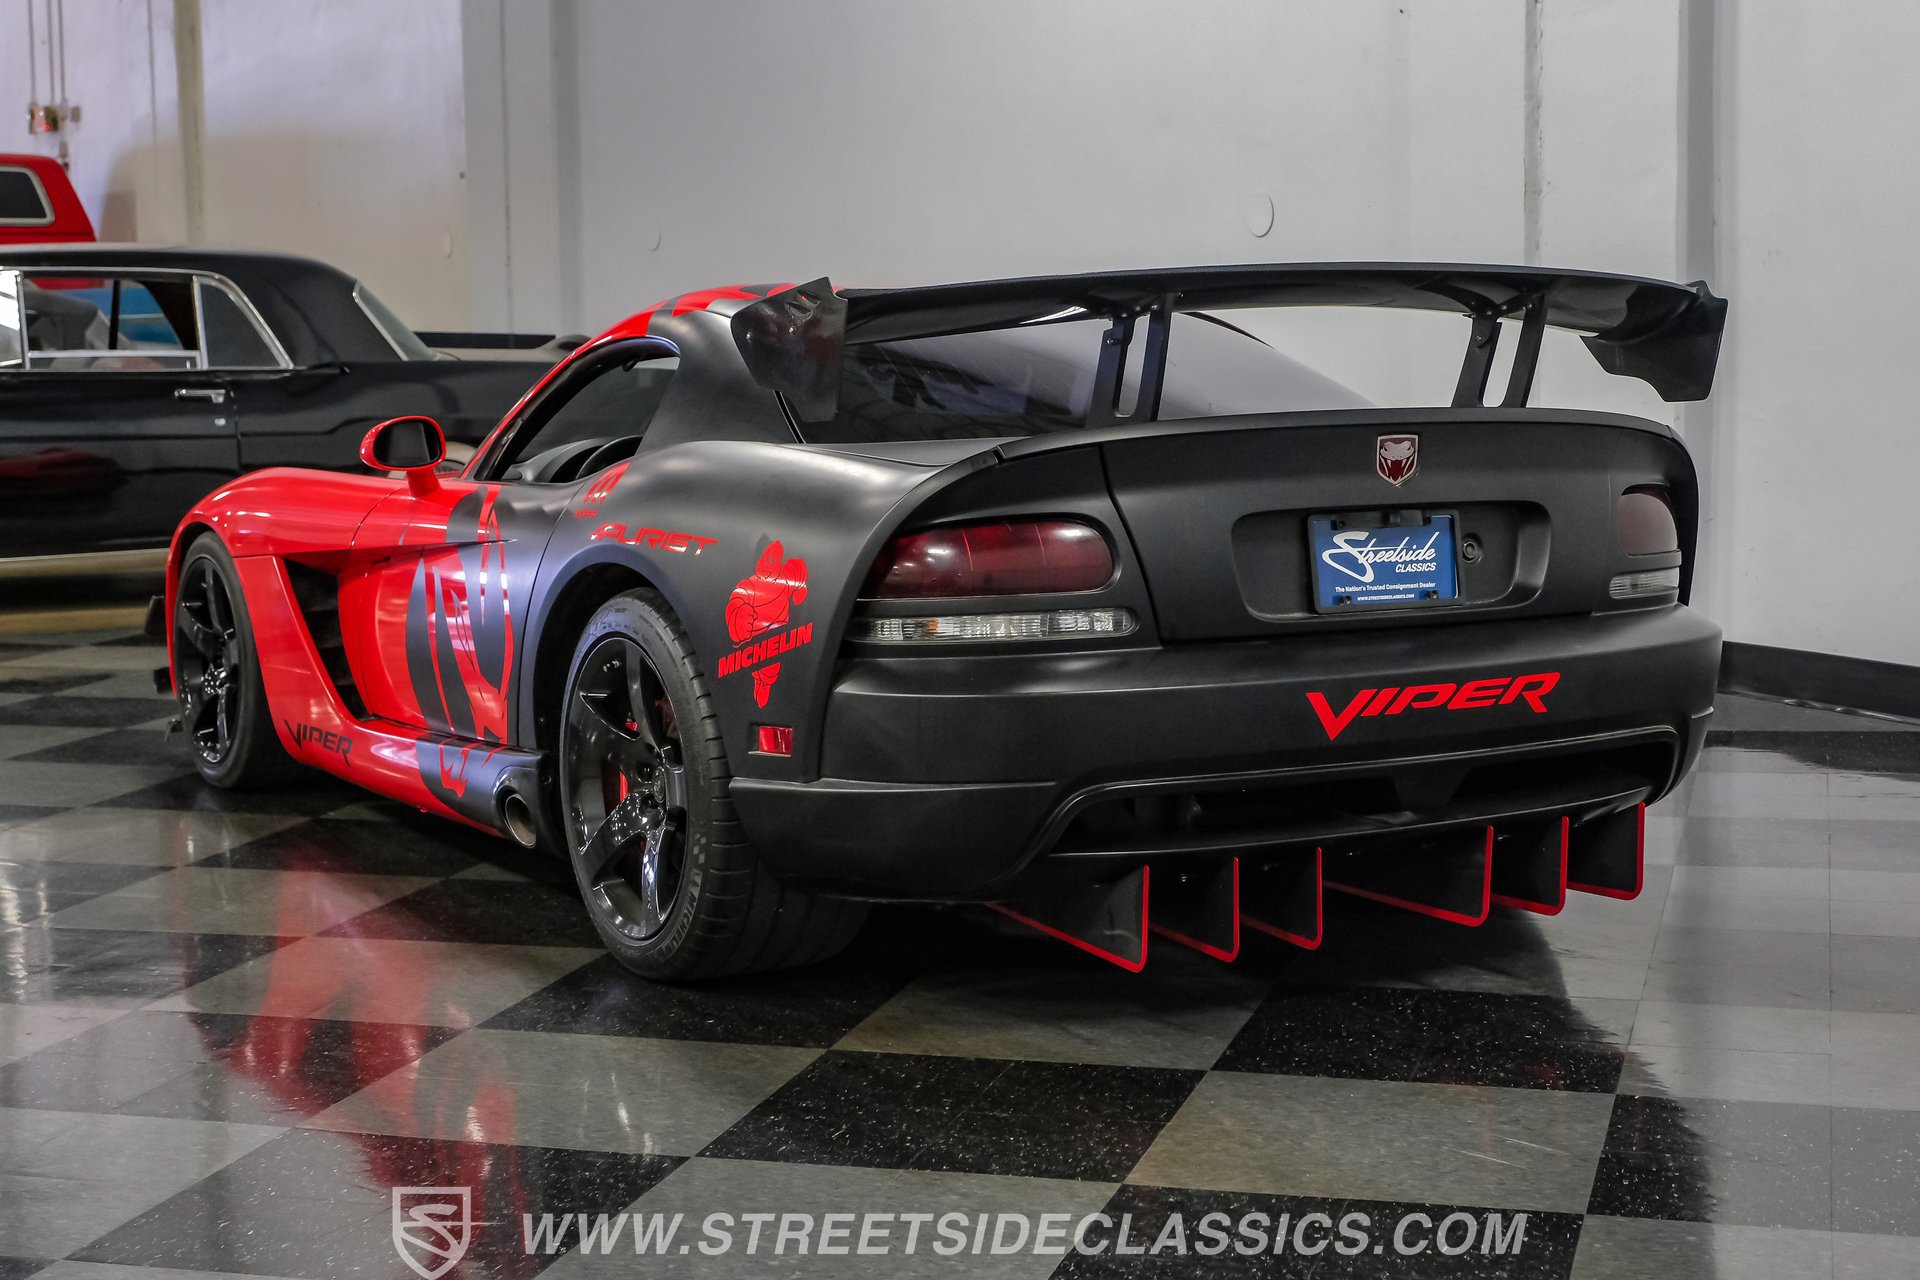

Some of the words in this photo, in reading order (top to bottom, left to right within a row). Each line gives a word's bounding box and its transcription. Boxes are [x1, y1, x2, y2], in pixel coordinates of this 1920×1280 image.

[590, 523, 718, 556] PURIST
[1322, 531, 1440, 583] Streetside
[1386, 583, 1419, 591] Consignment
[1395, 562, 1437, 573] CLASSICS
[718, 622, 814, 679] MICHELIN
[1306, 672, 1561, 741] VIPER
[284, 719, 353, 767] VIPER
